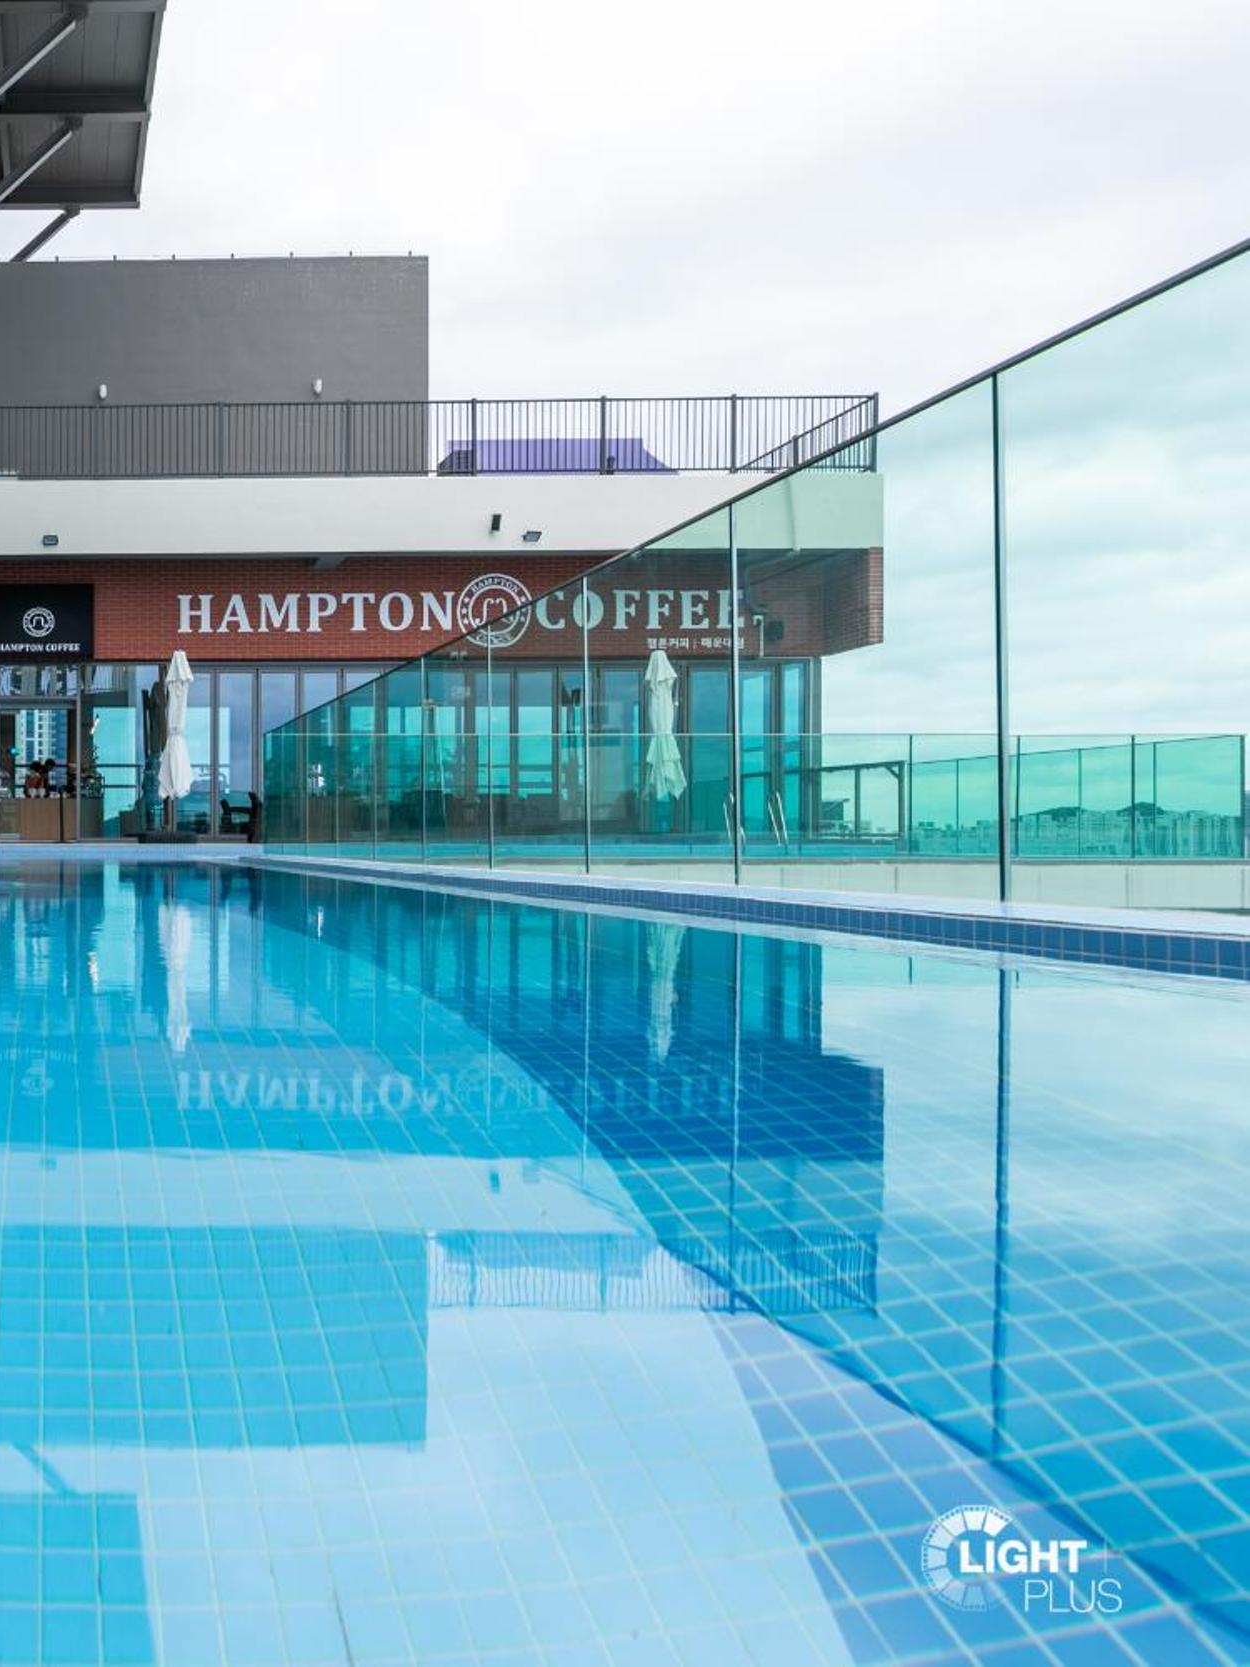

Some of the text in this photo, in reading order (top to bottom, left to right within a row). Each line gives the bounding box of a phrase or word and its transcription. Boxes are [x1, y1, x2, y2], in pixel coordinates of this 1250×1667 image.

[471, 578, 520, 593] HAMPTON
[177, 589, 745, 633] HAMPTON COFFEE
[45, 642, 81, 652] COFFEE
